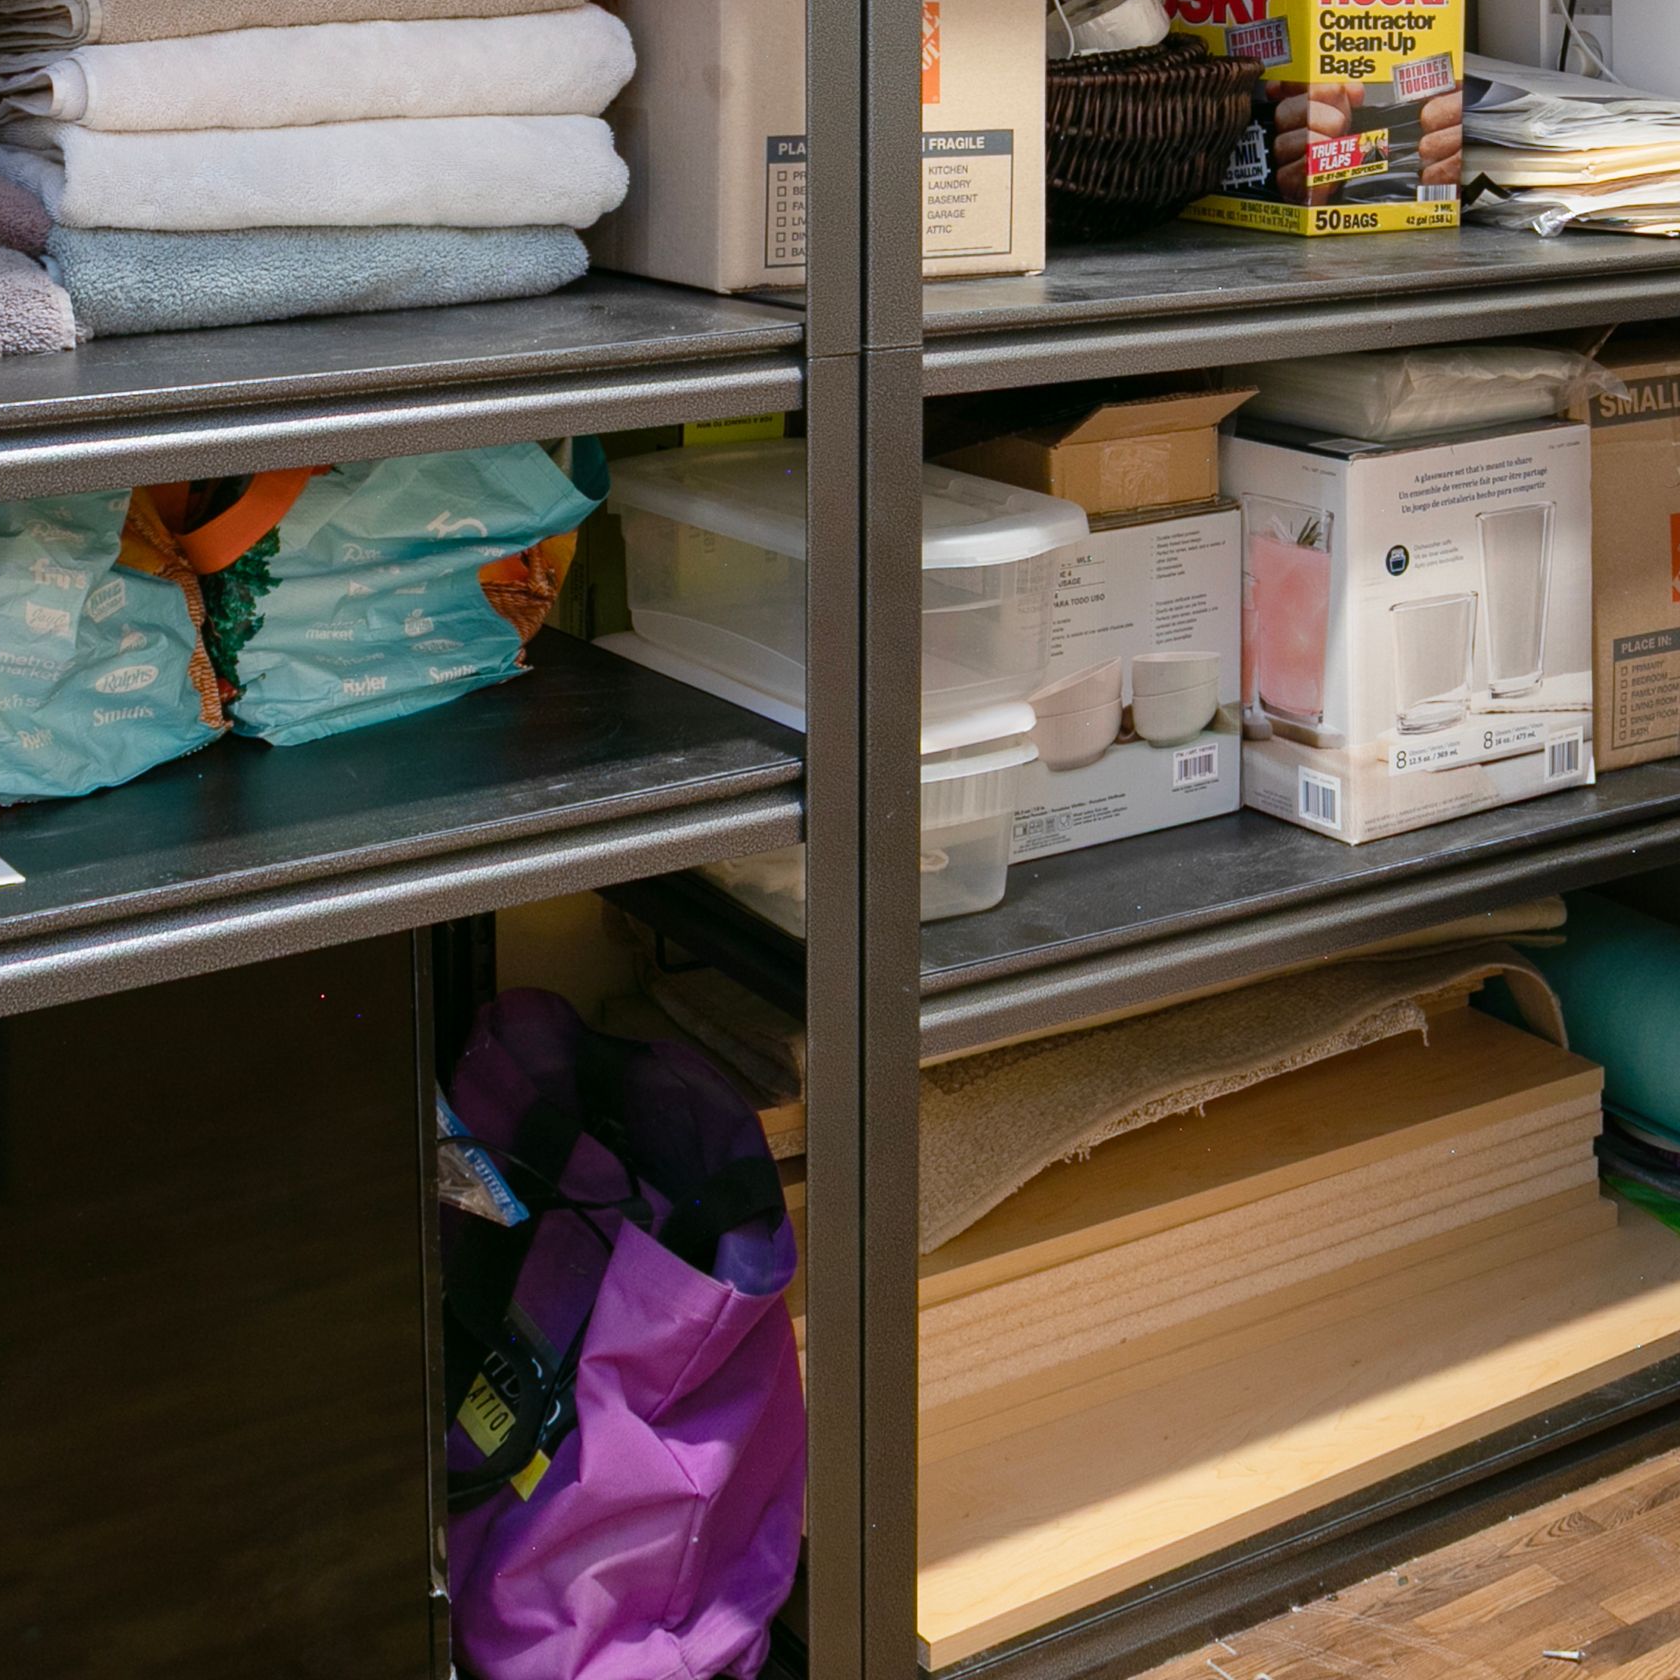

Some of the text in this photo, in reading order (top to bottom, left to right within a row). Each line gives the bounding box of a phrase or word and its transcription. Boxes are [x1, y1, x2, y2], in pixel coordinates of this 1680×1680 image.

[1320, 10, 1435, 30] Contractor
[1320, 55, 1375, 79] Bags
[1400, 71, 1449, 95] TOUGHER
[778, 142, 806, 156] PLA
[929, 136, 985, 150] FRAGILE
[1312, 139, 1357, 160] TRUE TIE
[1236, 143, 1261, 166] MIL
[1320, 154, 1351, 171] FLAPS
[929, 165, 968, 175] KITCHEN
[1234, 166, 1263, 179] GALLON
[928, 180, 971, 190] LAUNDRY
[928, 194, 978, 205] BASEMENT
[927, 210, 965, 220] GARAGE
[1315, 210, 1378, 231] 50 BAGS
[926, 225, 952, 234] ATTIC
[1421, 469, 1454, 483] glassware
[1455, 468, 1465, 478] set
[1486, 461, 1506, 472] meant
[1514, 455, 1533, 467] share
[1622, 635, 1672, 654] PLACE IN:
[103, 667, 154, 691] Ralphs
[93, 705, 155, 726] Smith's
[1483, 731, 1493, 750] 8
[1396, 751, 1407, 769] 8
